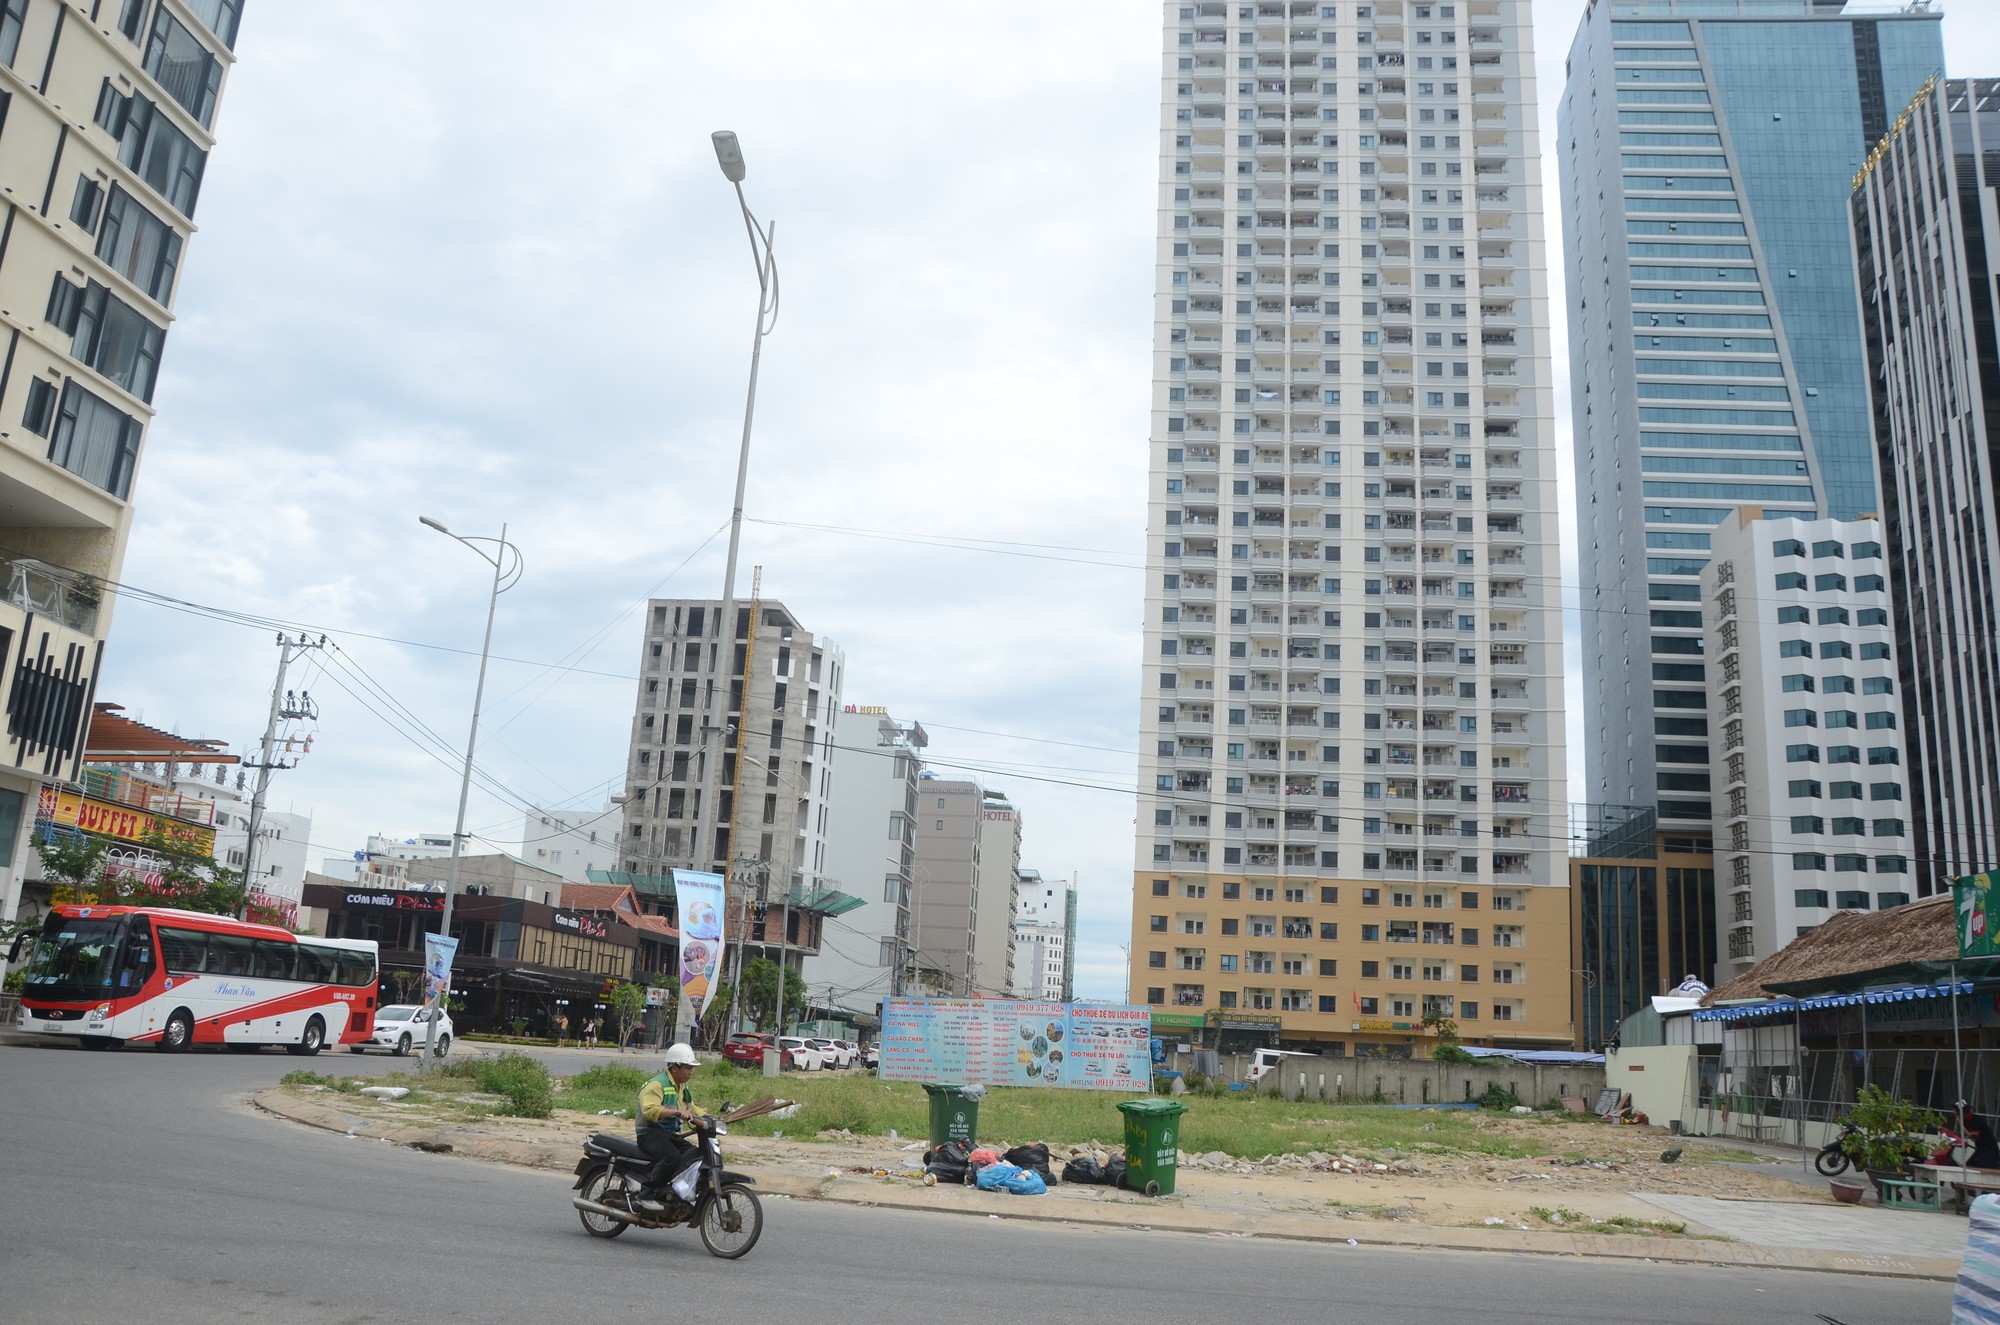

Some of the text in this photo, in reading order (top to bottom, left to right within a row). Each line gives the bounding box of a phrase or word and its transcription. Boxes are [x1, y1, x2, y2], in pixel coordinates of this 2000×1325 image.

[859, 705, 887, 716] HOTEL
[77, 802, 138, 838] BUFFET
[983, 810, 1012, 822] HOTEL
[346, 893, 370, 905] CƠM
[1016, 1003, 1034, 1011] 0919
[1036, 1004, 1049, 1012] 377
[1051, 1004, 1065, 1013] 028
[1071, 1008, 1083, 1018] CHO
[1099, 1009, 1107, 1019] XE
[1108, 1010, 1115, 1019] DU
[1095, 1079, 1114, 1087] 0919
[1116, 1079, 1130, 1088] 377
[1132, 1080, 1146, 1089] 028
